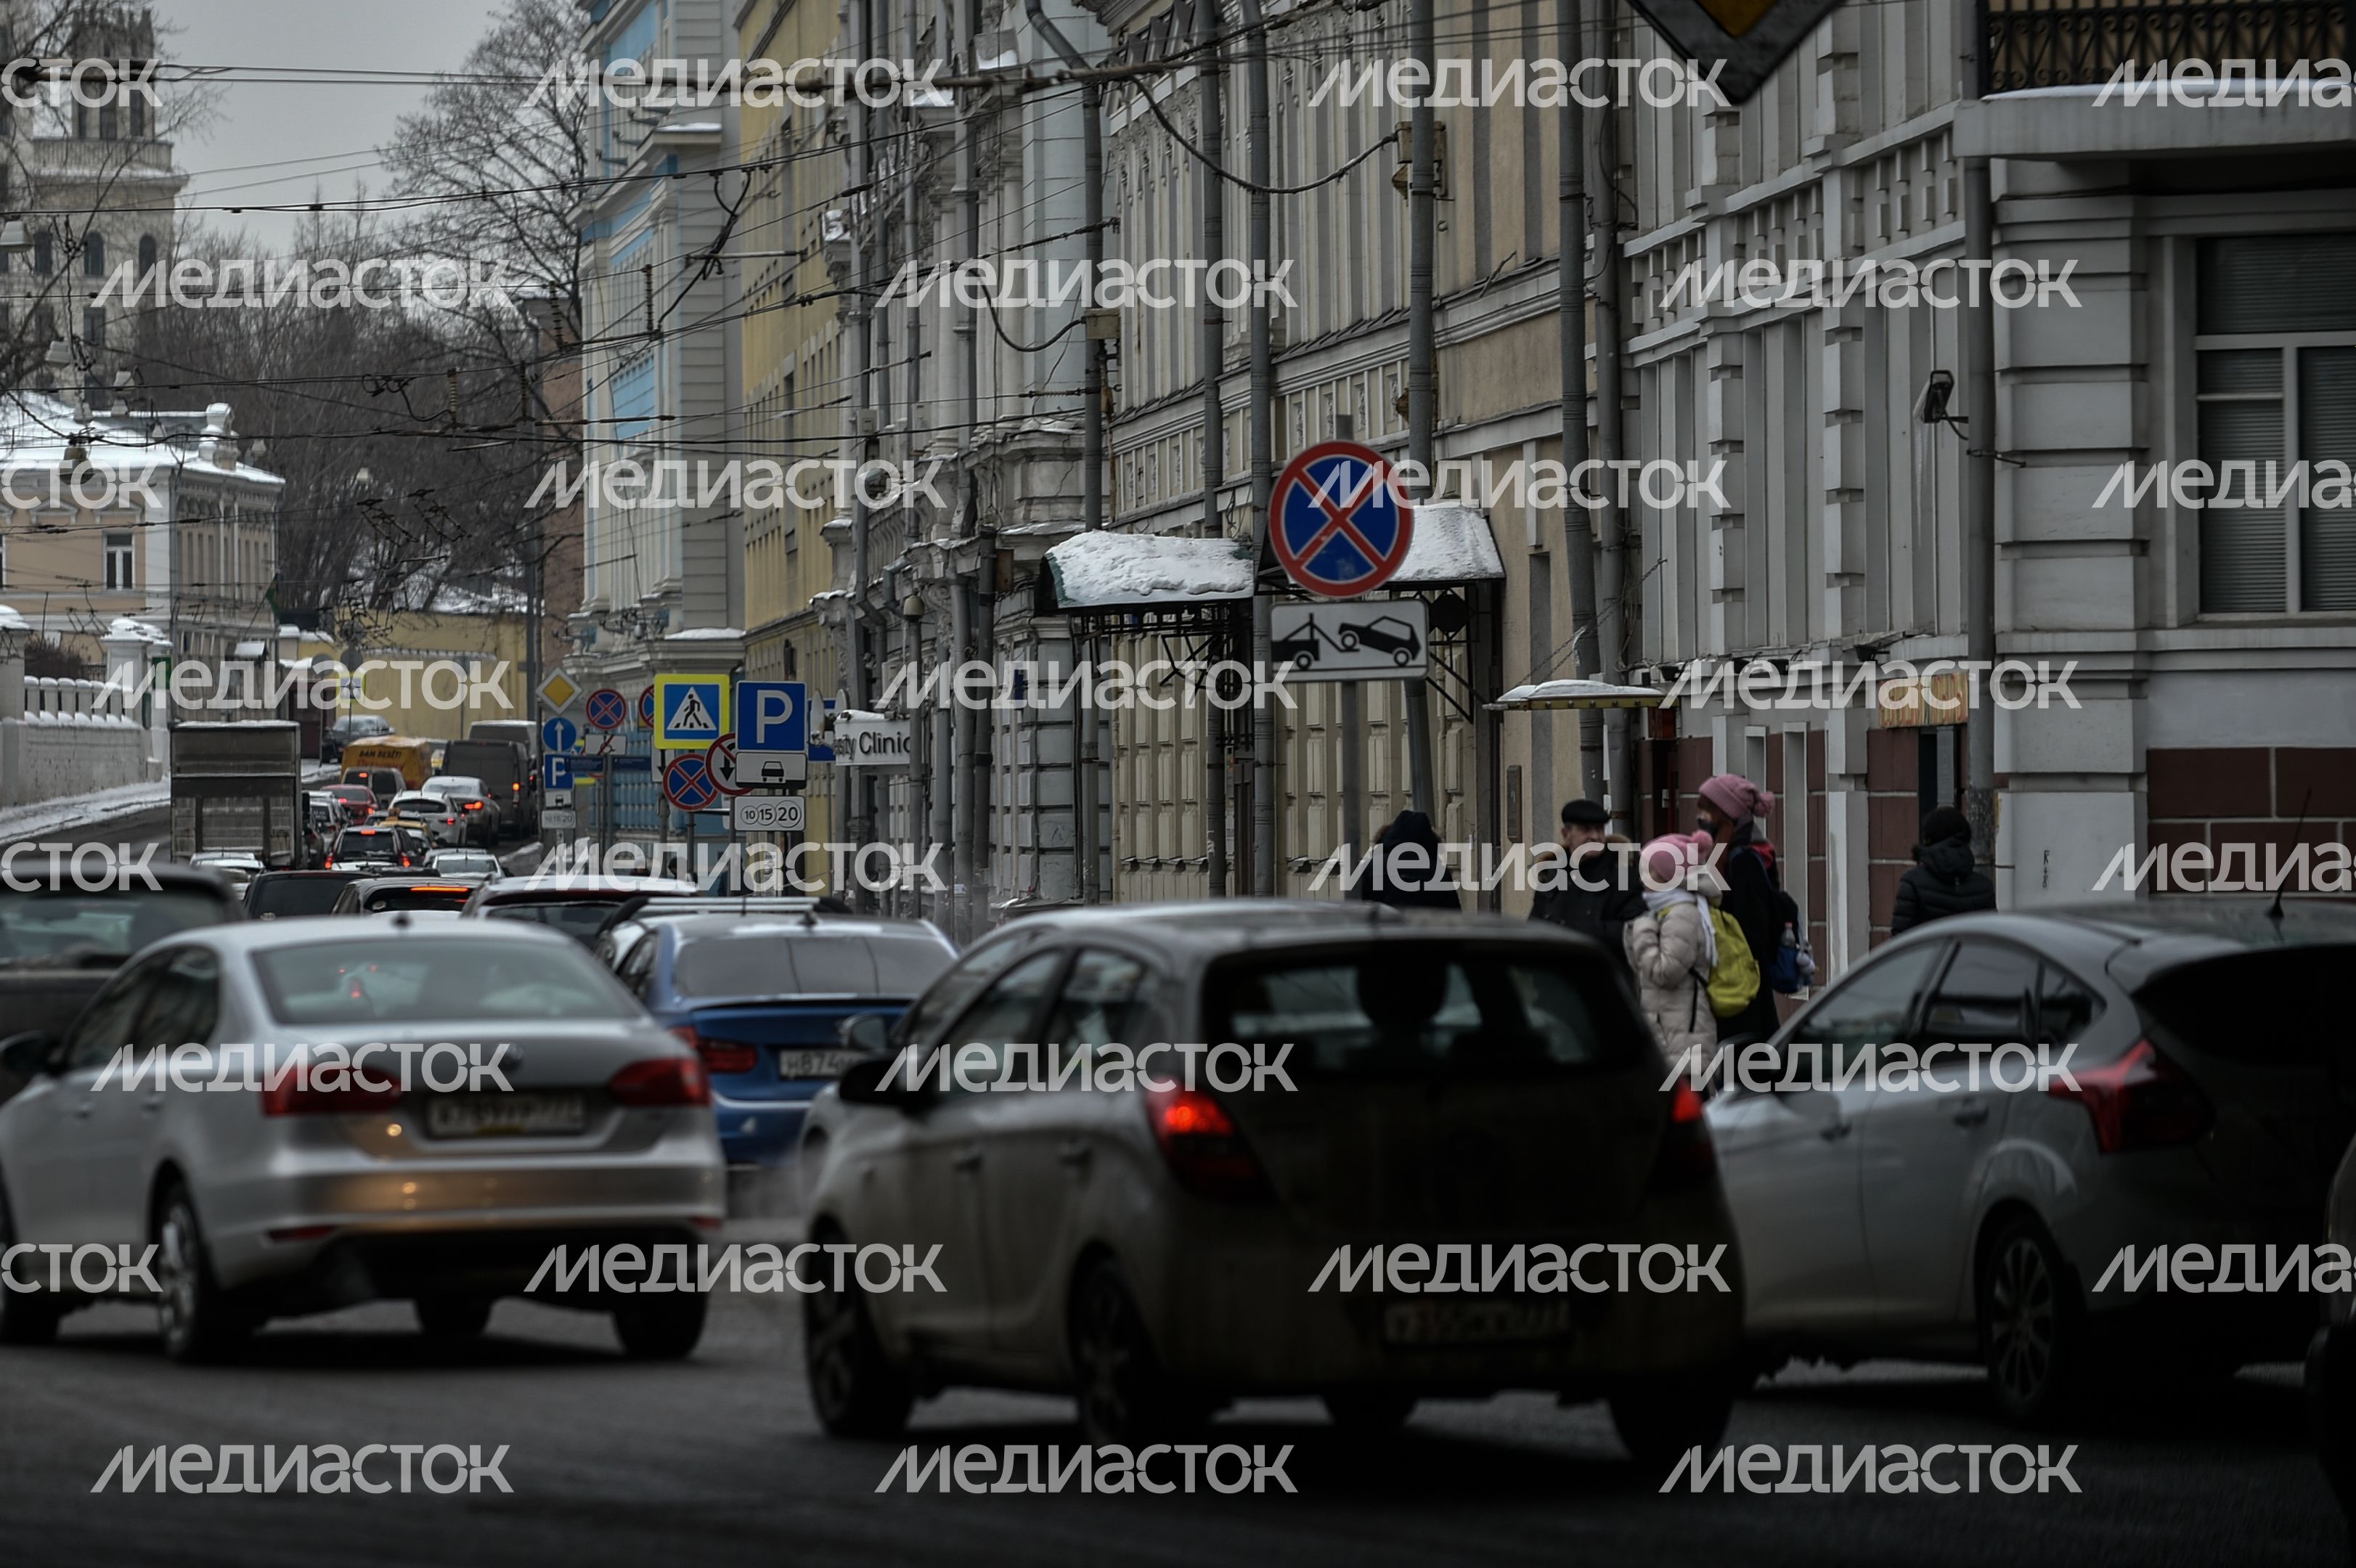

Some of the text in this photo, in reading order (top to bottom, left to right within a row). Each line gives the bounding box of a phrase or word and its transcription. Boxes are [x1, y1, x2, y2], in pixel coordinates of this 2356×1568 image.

[757, 690, 793, 743] P
[859, 731, 910, 755] Clinic
[745, 807, 798, 822] 10 15 20
